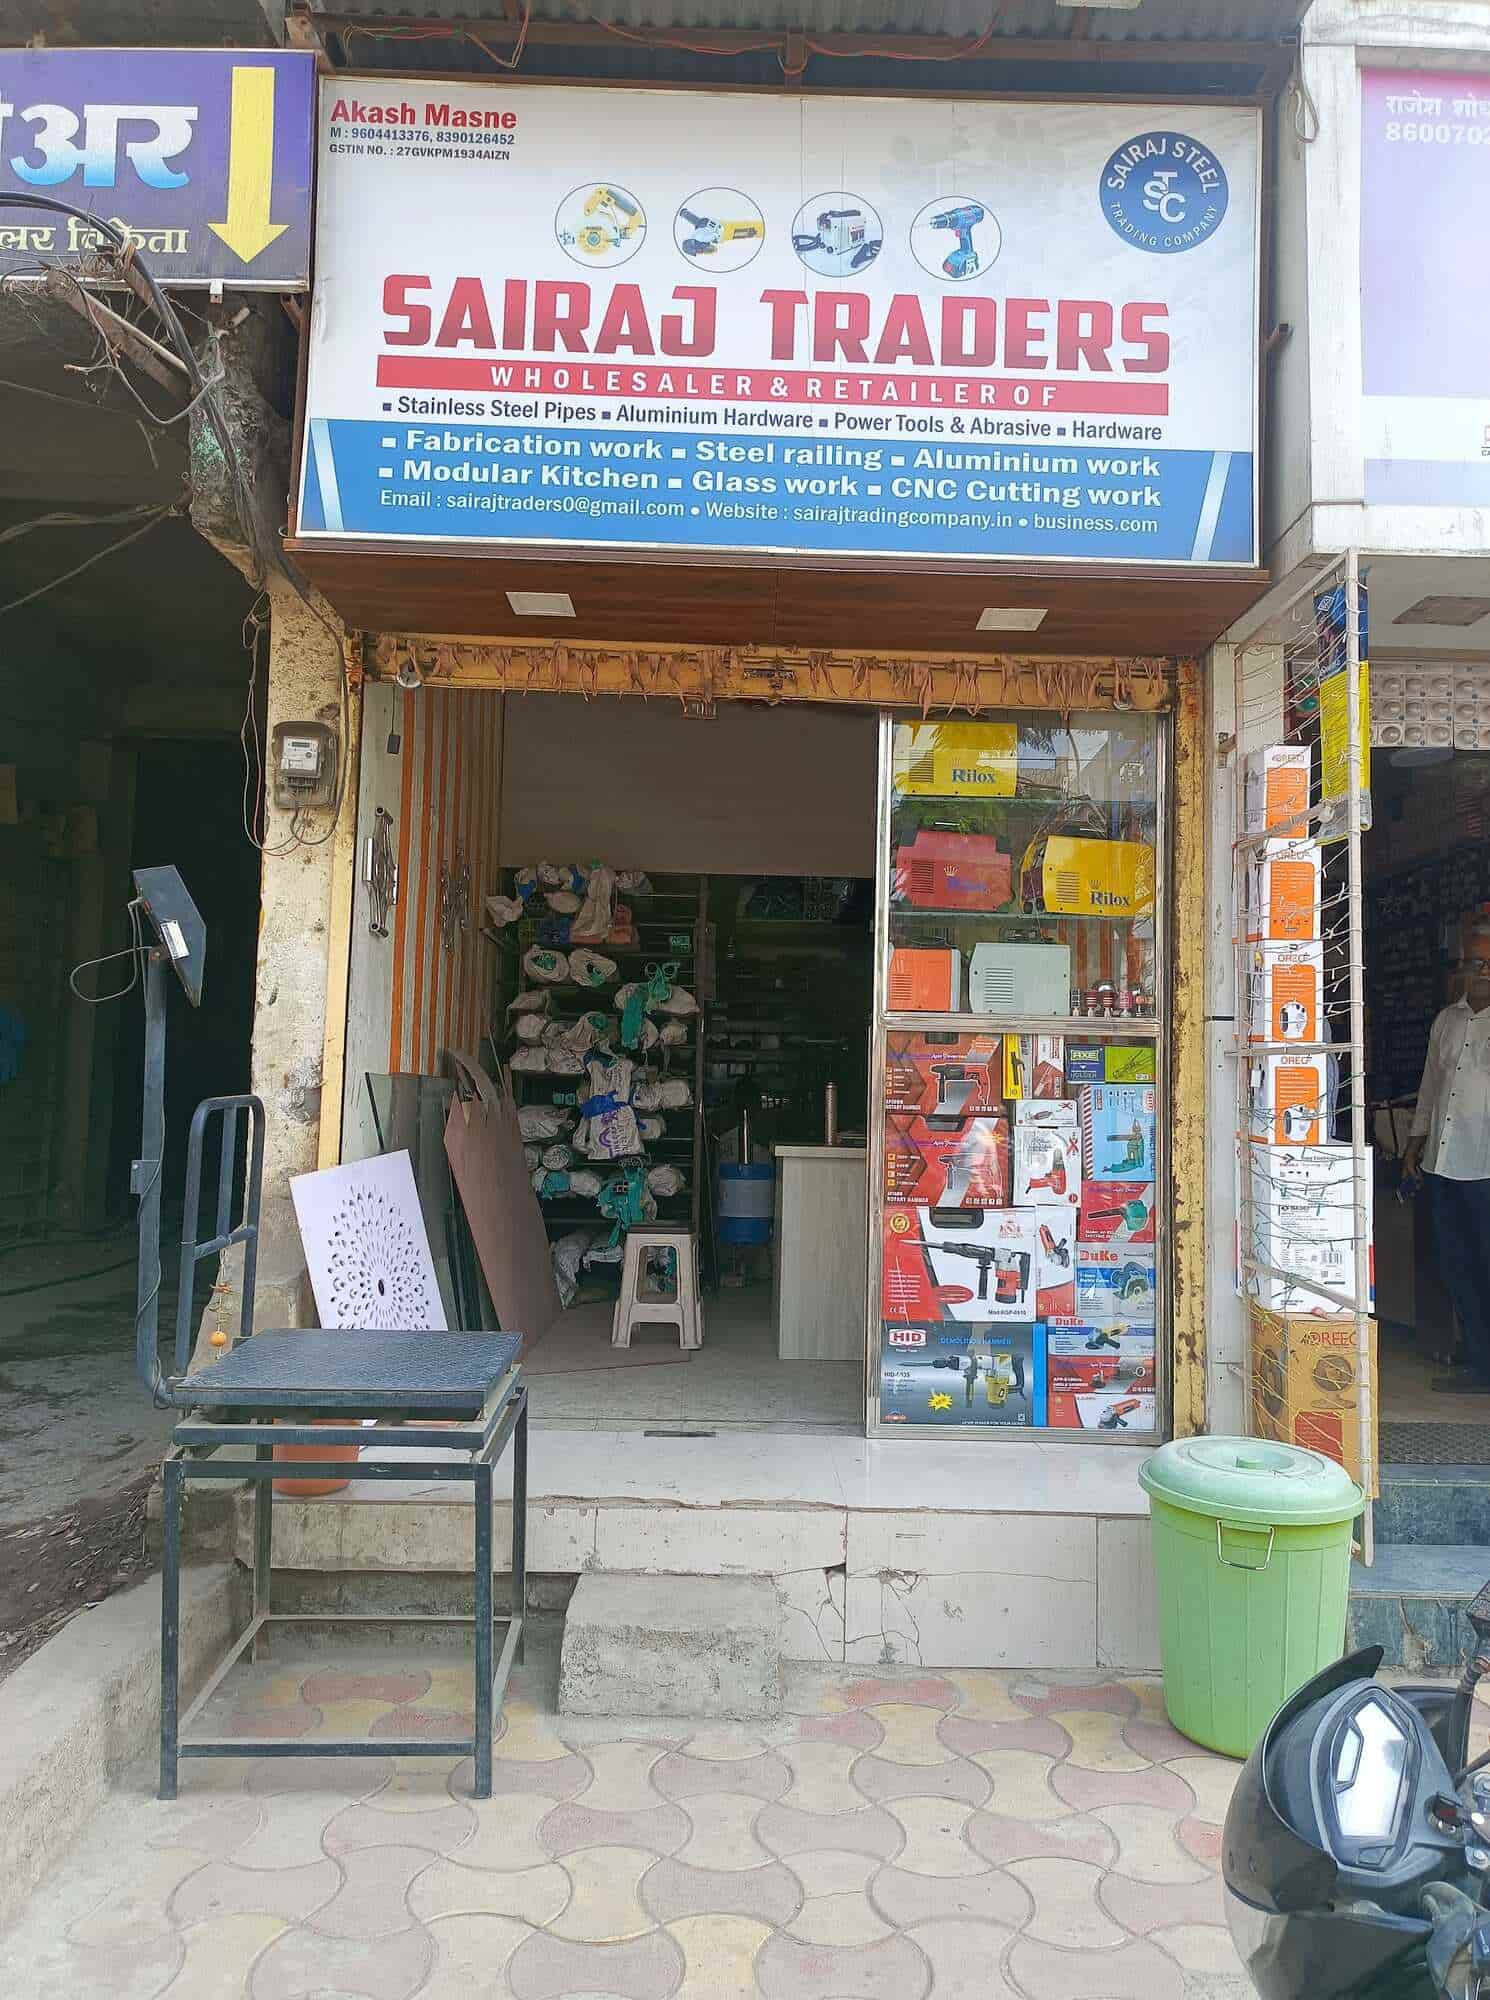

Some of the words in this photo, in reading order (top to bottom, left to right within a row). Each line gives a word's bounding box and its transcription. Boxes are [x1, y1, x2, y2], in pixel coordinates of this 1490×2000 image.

[330, 100, 416, 125] Akash
[425, 103, 517, 129] Masne
[330, 127, 342, 138] M
[436, 131, 515, 145] 8390126452
[0, 104, 198, 189] अर
[329, 144, 364, 155] GSTIN
[1107, 138, 1167, 190] SAIRAJ
[1172, 141, 1220, 194] STEEL
[1111, 201, 1158, 246] TRADING
[1164, 205, 1217, 247] COMPANY
[383, 274, 717, 358] SAIRAJ
[760, 289, 1170, 374] TRADERS
[490, 365, 751, 396] WHOLESALER
[769, 376, 788, 398] &
[806, 376, 996, 405] RETAILER
[1013, 385, 1058, 407] OF
[398, 395, 485, 417] Stainless
[490, 399, 539, 419] Steel
[544, 401, 597, 423] Pipes
[616, 403, 718, 426] Aluminium
[724, 407, 814, 430] Hardware
[834, 412, 893, 432] Power
[895, 413, 945, 434] Tools
[950, 416, 966, 434] &
[970, 416, 1052, 437] Abrasive
[1071, 420, 1163, 441] Hardware
[405, 429, 581, 457] Fabrication
[589, 438, 663, 460] work
[695, 440, 775, 463] Steel
[783, 442, 884, 471] railing
[913, 447, 1079, 474] Aluminium
[1087, 455, 1161, 478] work
[402, 459, 533, 486] Modular
[541, 464, 659, 490] Kitchen
[691, 470, 777, 494] Glass
[784, 474, 859, 497] work
[890, 477, 958, 500] CNC
[966, 479, 1081, 508] Cutting
[1088, 486, 1161, 508] work
[380, 489, 431, 508] Email
[446, 493, 685, 518] sairajtraders0@gmail.com
[706, 501, 779, 520] Website
[793, 504, 1013, 530] sairajtradingcompany.in
[1033, 513, 1158, 533] business.com
[952, 769, 997, 784] Rilox
[1089, 890, 1131, 907] Rilox
[893, 1332, 923, 1343] HID
